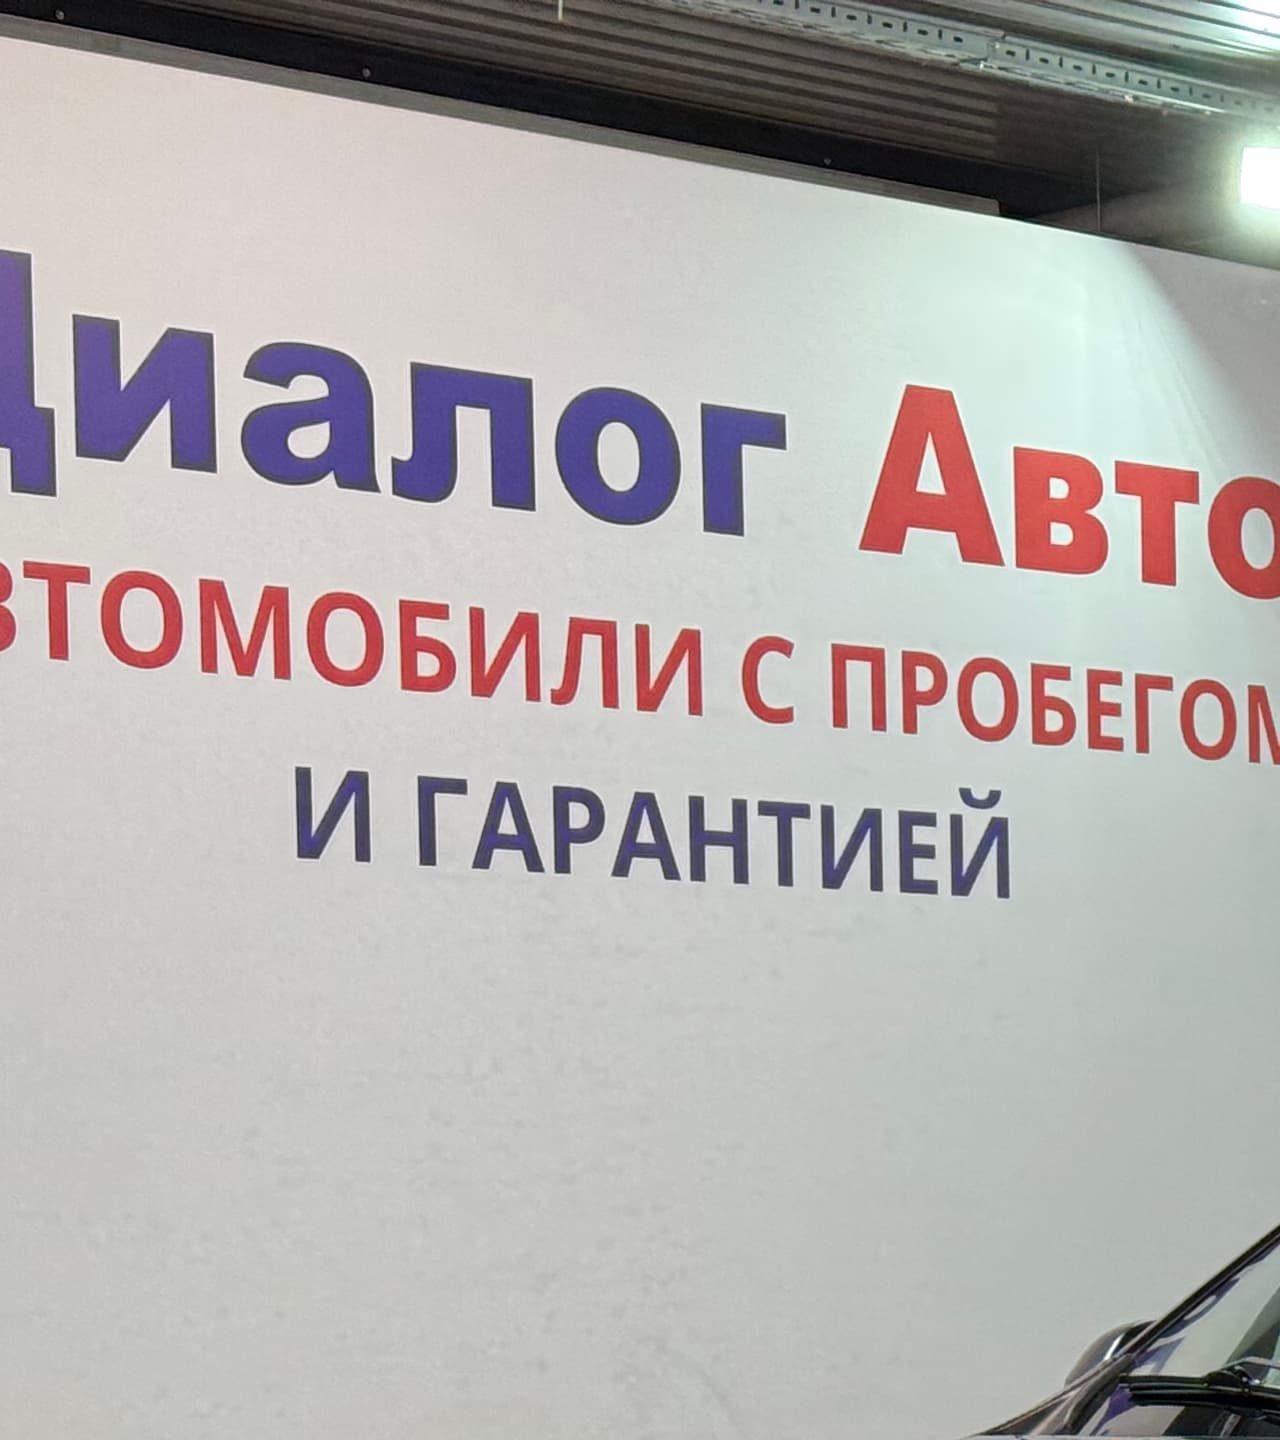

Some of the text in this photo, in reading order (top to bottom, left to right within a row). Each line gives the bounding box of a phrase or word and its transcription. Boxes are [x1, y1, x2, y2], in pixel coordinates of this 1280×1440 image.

[0, 249, 788, 538] иалог
[0, 558, 704, 717] ТОМОБИЛИ
[741, 634, 795, 726] С
[294, 765, 1011, 900] И ГАРАНТИЕЙ
